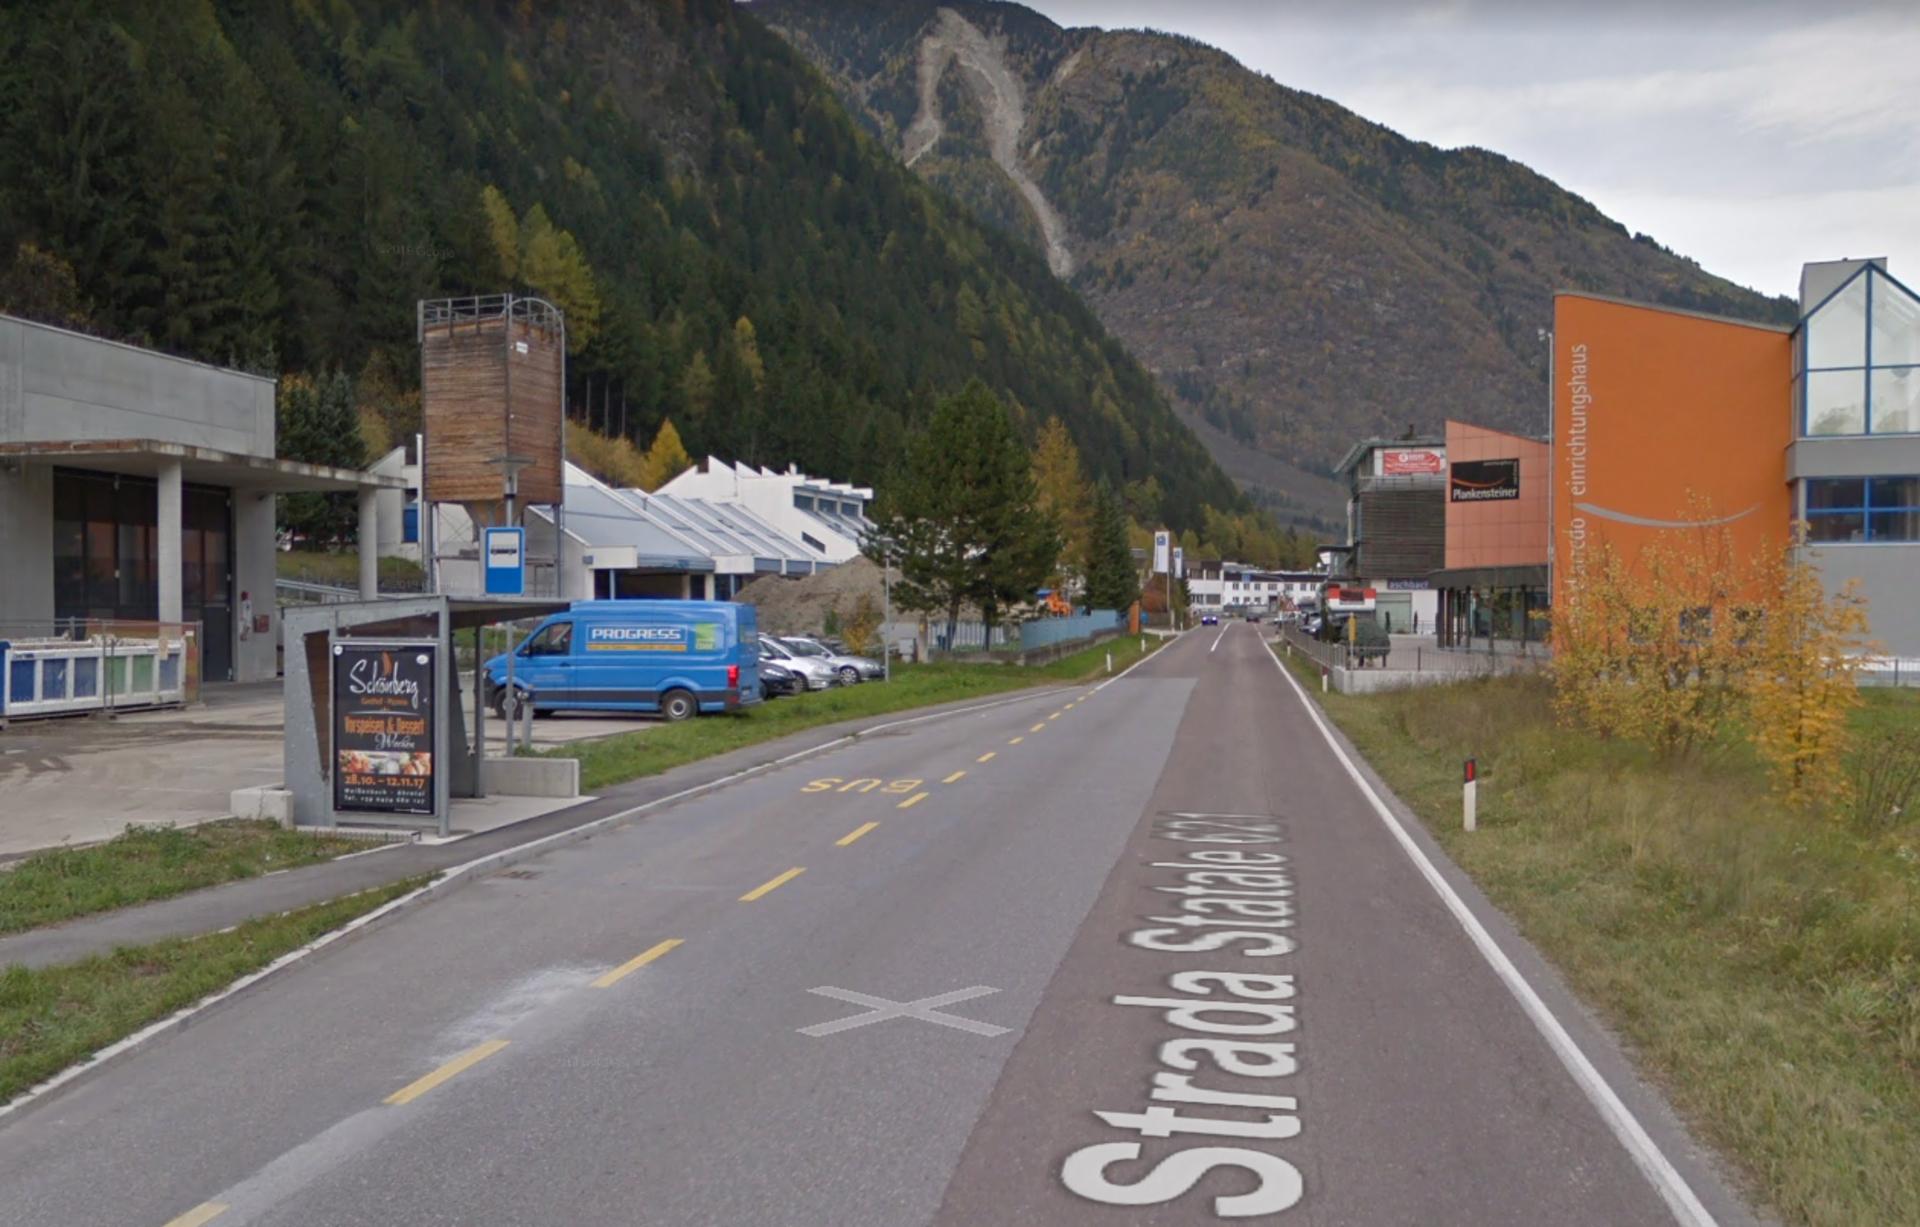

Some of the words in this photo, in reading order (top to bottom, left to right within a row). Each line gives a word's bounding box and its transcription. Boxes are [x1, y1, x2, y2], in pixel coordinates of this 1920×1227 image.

[1565, 343, 1592, 496] einrichtungshaus
[1453, 487, 1518, 501] Plankensteiner
[591, 628, 682, 640] PROGRESS
[349, 659, 419, 710] Schönberg
[344, 716, 385, 736] Vorspeisen
[396, 717, 424, 735] Dessert
[386, 776, 425, 789] 12.11.17
[801, 777, 925, 793] BUS
